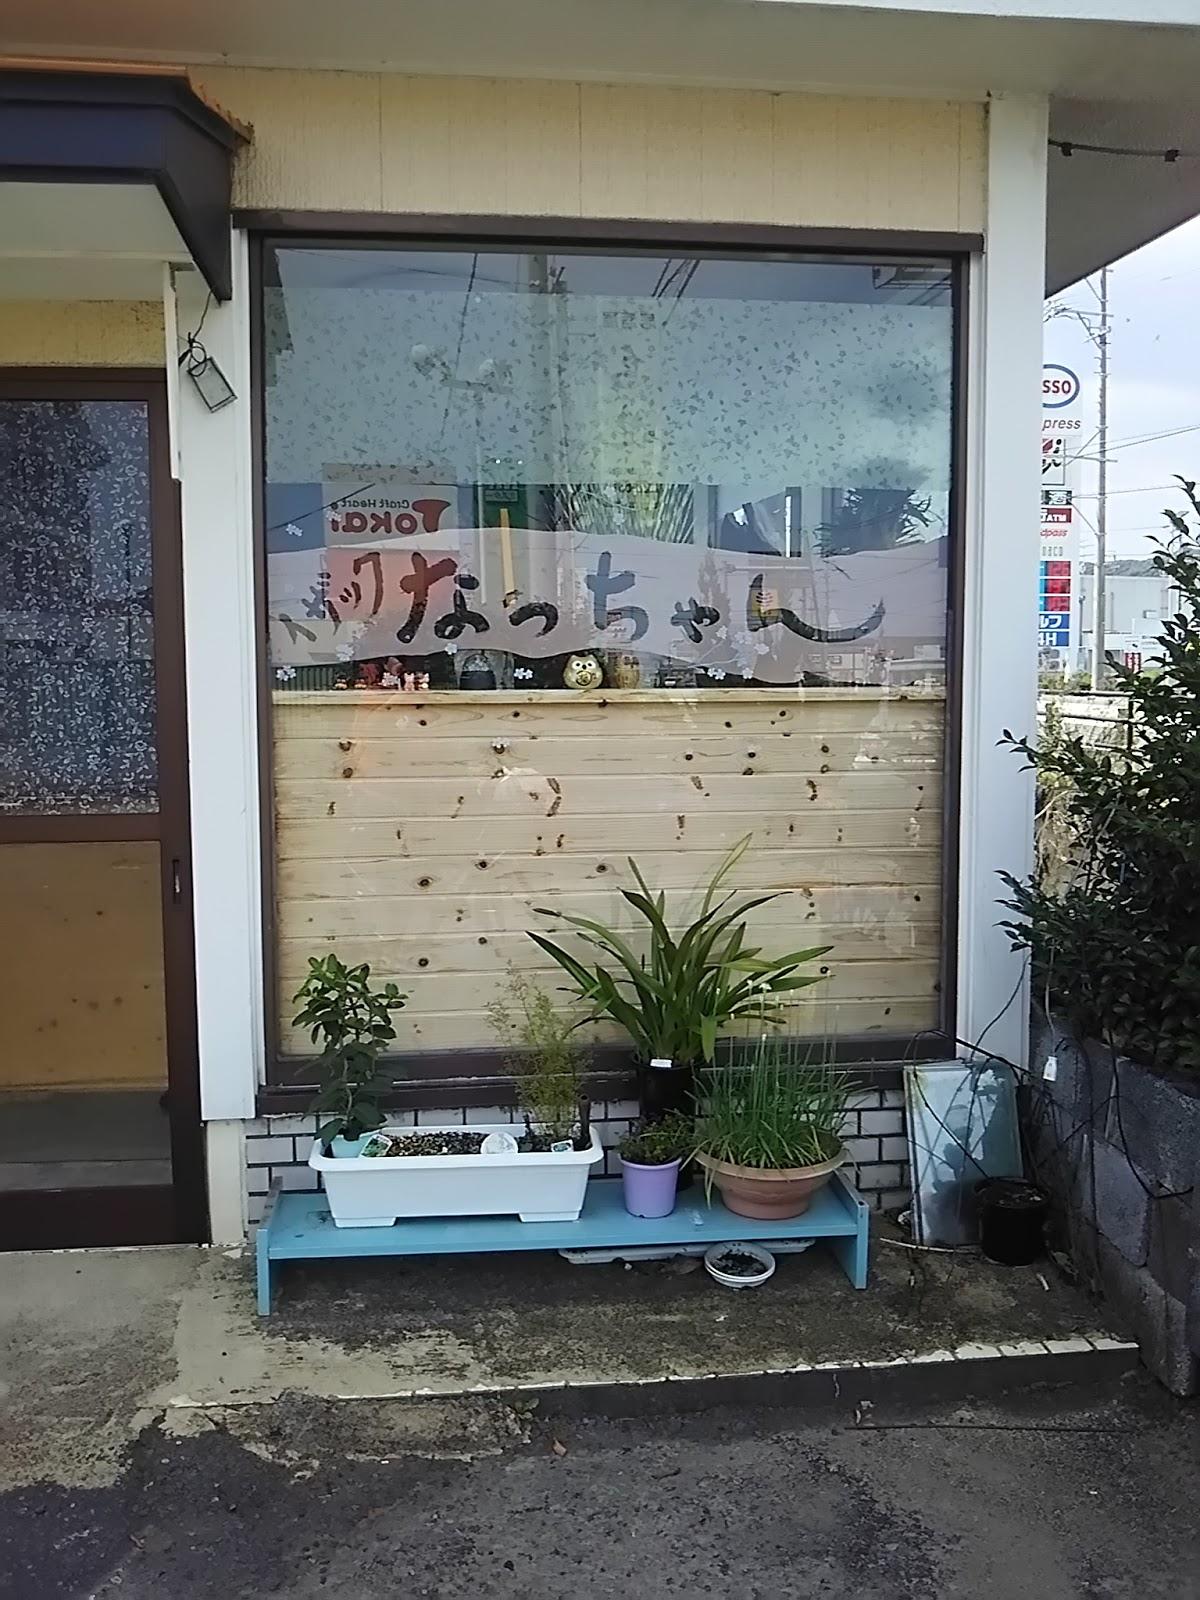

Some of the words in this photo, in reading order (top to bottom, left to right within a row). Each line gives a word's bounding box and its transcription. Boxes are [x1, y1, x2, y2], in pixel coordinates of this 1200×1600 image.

[1042, 380, 1072, 394] SSO
[1042, 419, 1081, 431] press
[396, 550, 886, 645] なっちゃん
